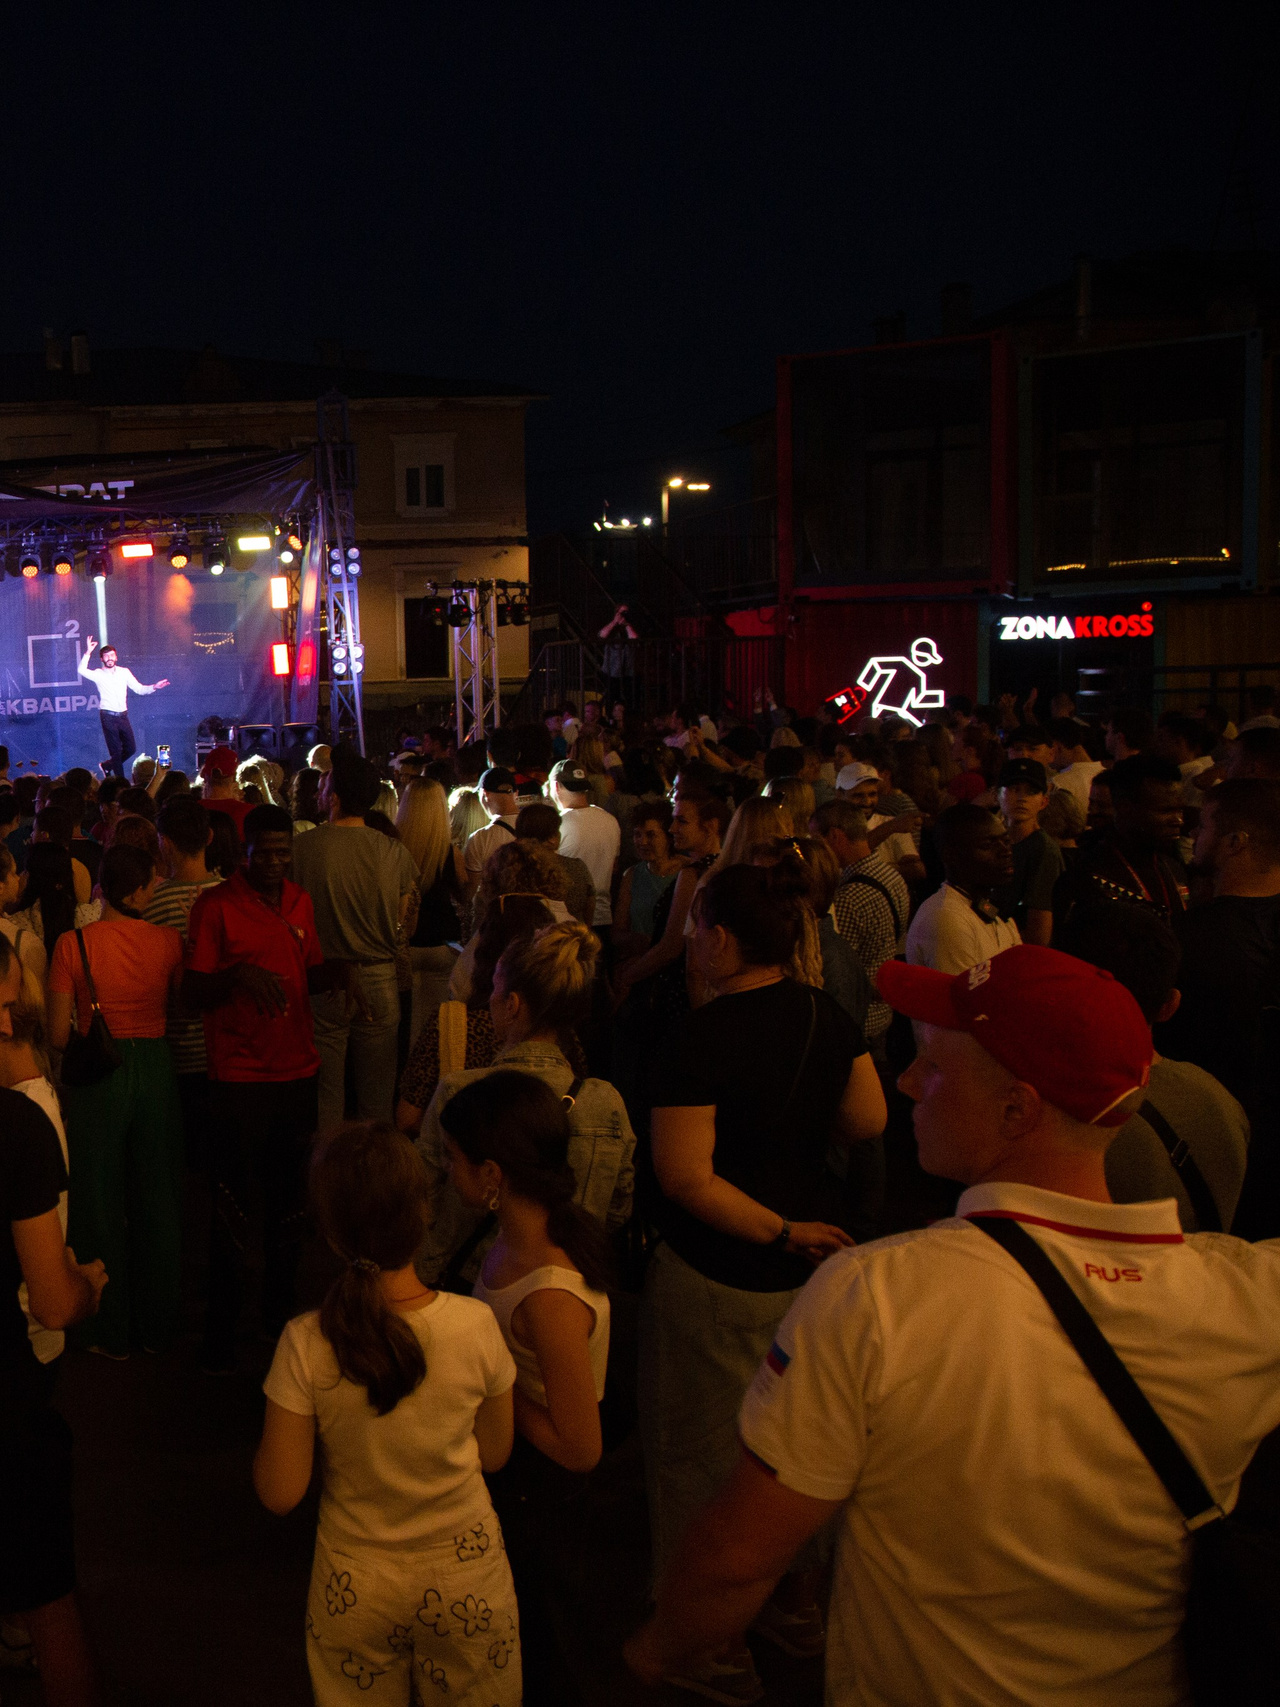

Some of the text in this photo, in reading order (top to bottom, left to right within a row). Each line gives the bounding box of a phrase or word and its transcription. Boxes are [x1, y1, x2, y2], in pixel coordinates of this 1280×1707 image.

[65, 620, 80, 638] 2
[7, 694, 101, 716] КВАДРА
[1084, 1262, 1142, 1282] RUS
